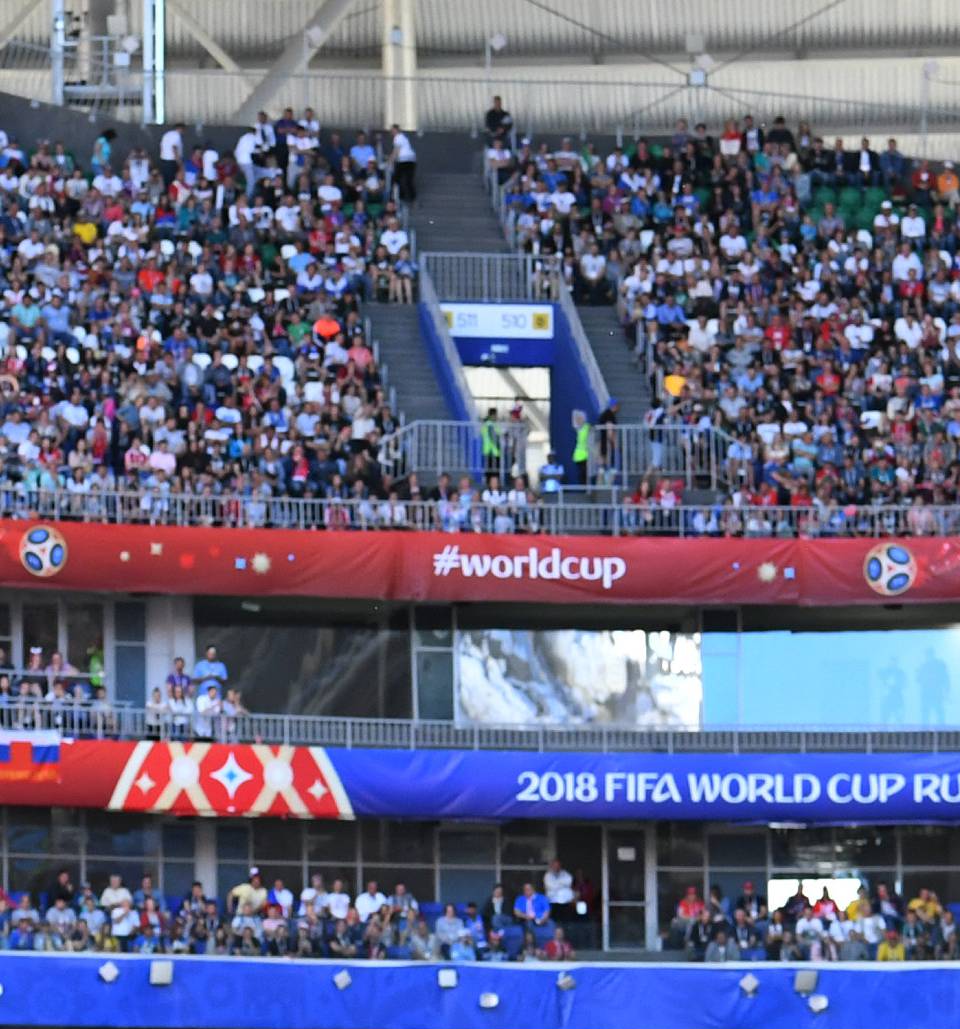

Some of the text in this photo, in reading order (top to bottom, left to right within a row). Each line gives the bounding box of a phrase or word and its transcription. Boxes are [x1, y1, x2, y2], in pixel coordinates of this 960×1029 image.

[433, 544, 627, 589] #worldcup
[516, 770, 598, 802] 2018
[605, 771, 682, 803] FIFA
[687, 772, 821, 804] WORLD
[826, 772, 906, 804] CUP
